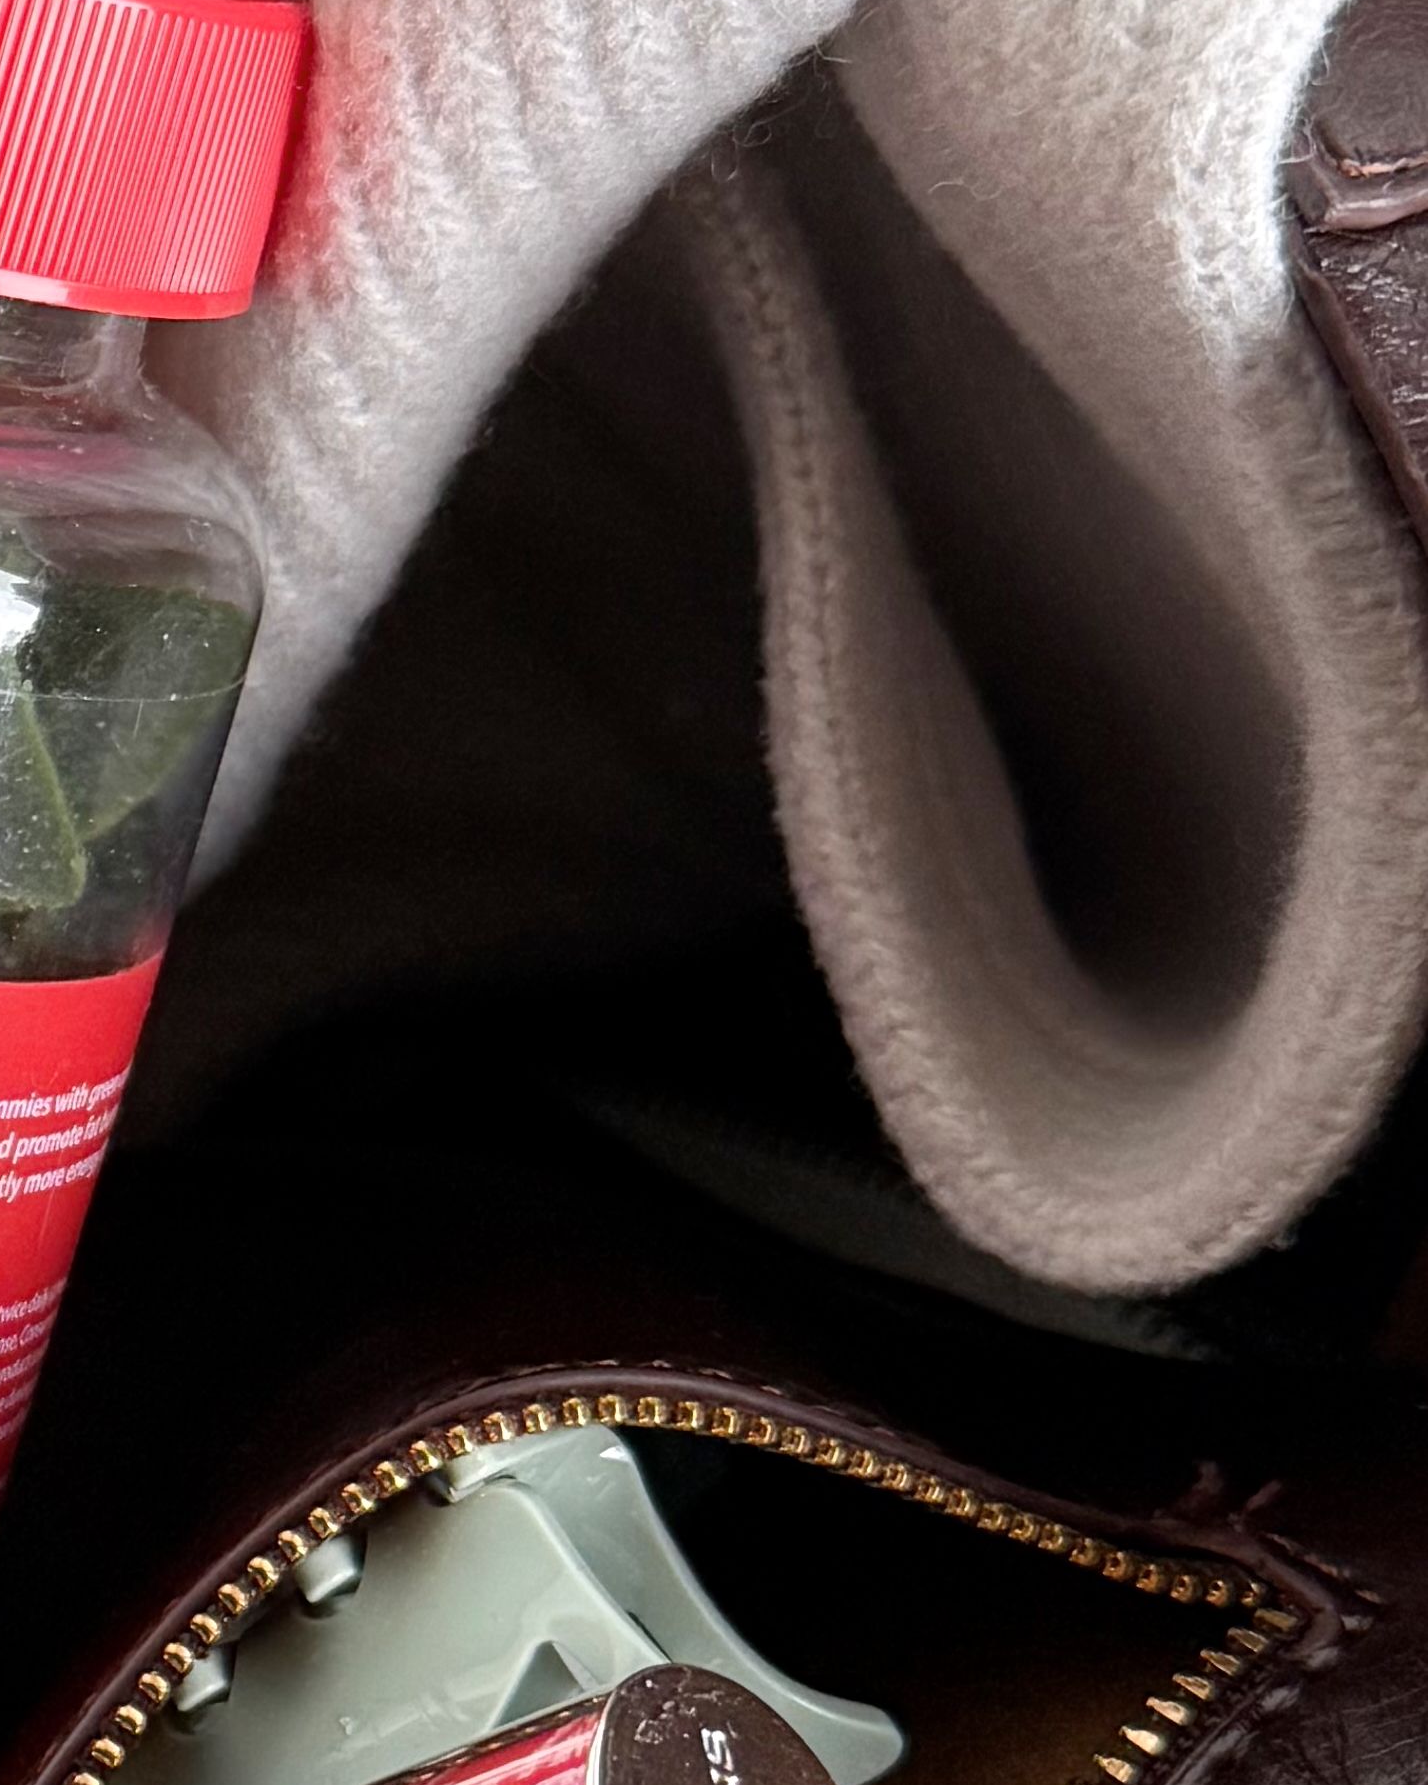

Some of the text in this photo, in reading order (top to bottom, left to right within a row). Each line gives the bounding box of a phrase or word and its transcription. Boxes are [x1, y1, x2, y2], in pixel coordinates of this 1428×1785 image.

[55, 1081, 89, 1113] with
[12, 1124, 84, 1164] promote
[24, 1166, 64, 1194] more
